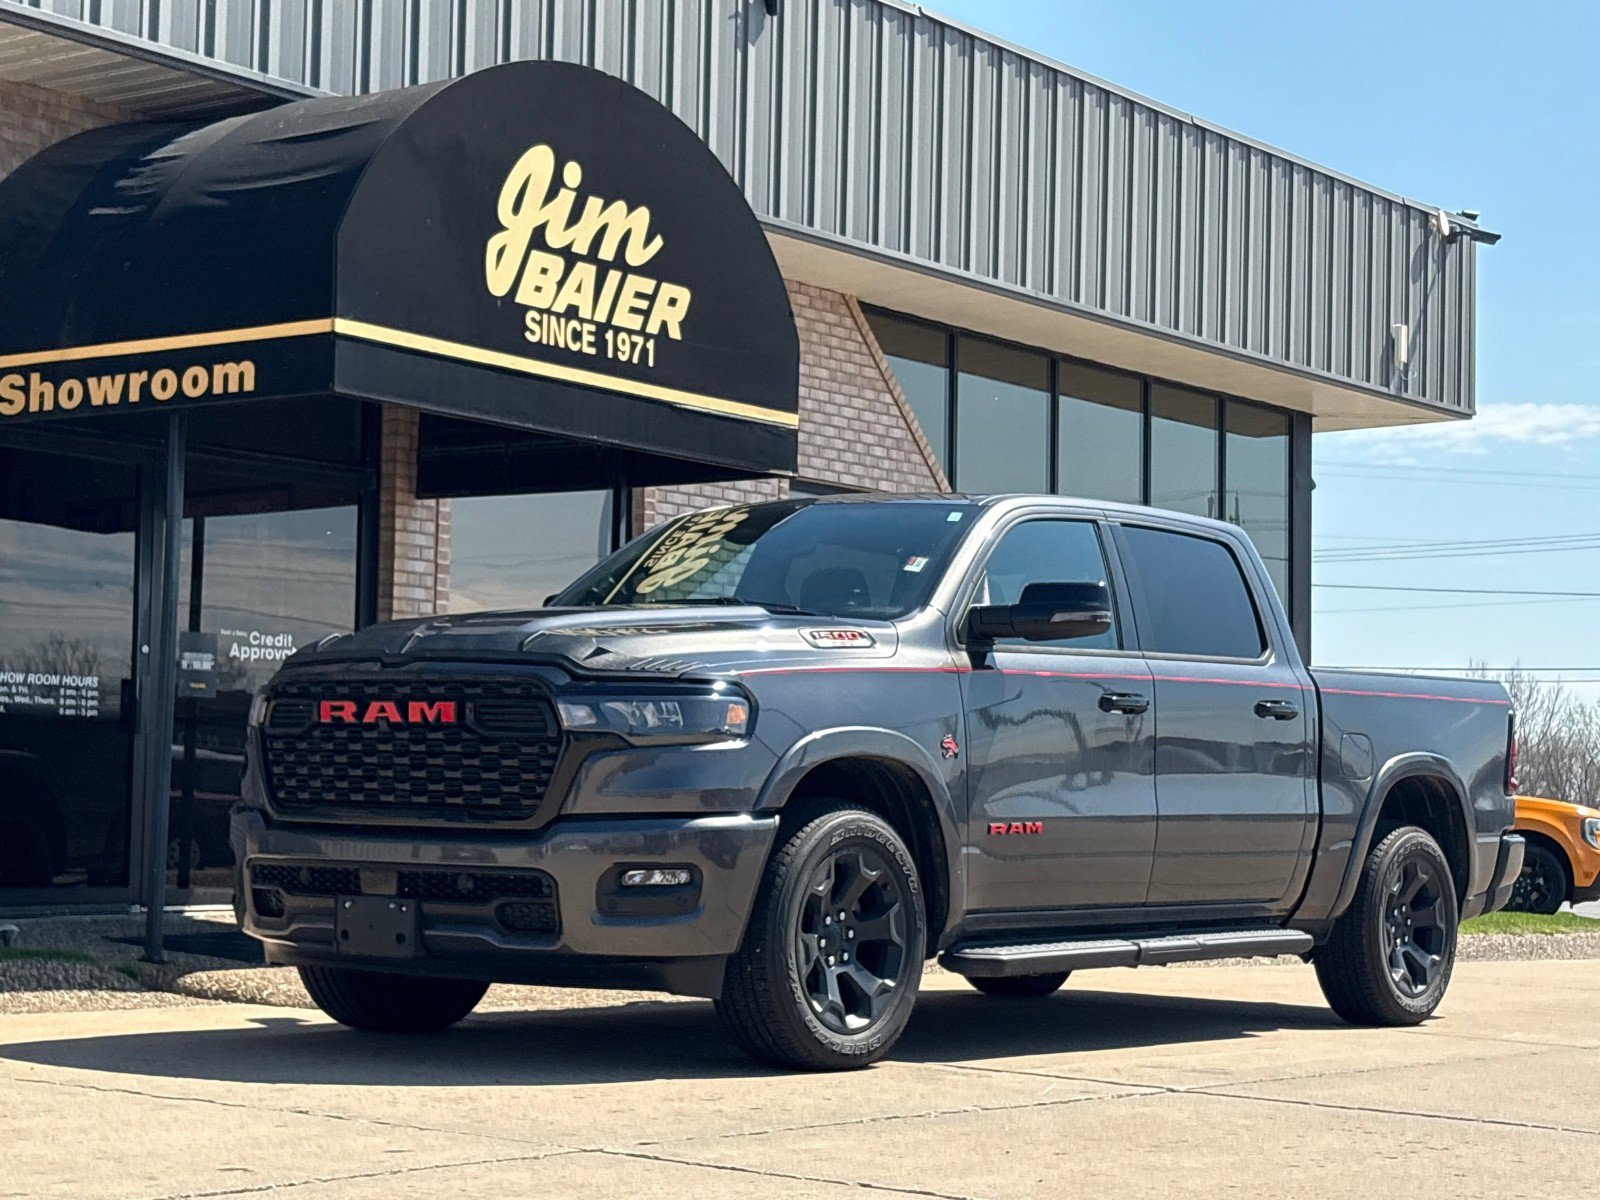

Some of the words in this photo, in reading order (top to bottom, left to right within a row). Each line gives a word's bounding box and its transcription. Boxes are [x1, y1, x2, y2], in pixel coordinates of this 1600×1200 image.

[514, 249, 691, 341] BAIER
[524, 310, 597, 355] SINCE
[605, 329, 655, 367] 1971
[0, 360, 256, 416] Showroom
[249, 631, 293, 647] Credit
[810, 630, 868, 641] 1500
[27, 673, 60, 686] ROOM
[62, 675, 99, 688] HOURS
[319, 701, 456, 723] RAM
[987, 822, 1043, 836] RAM
